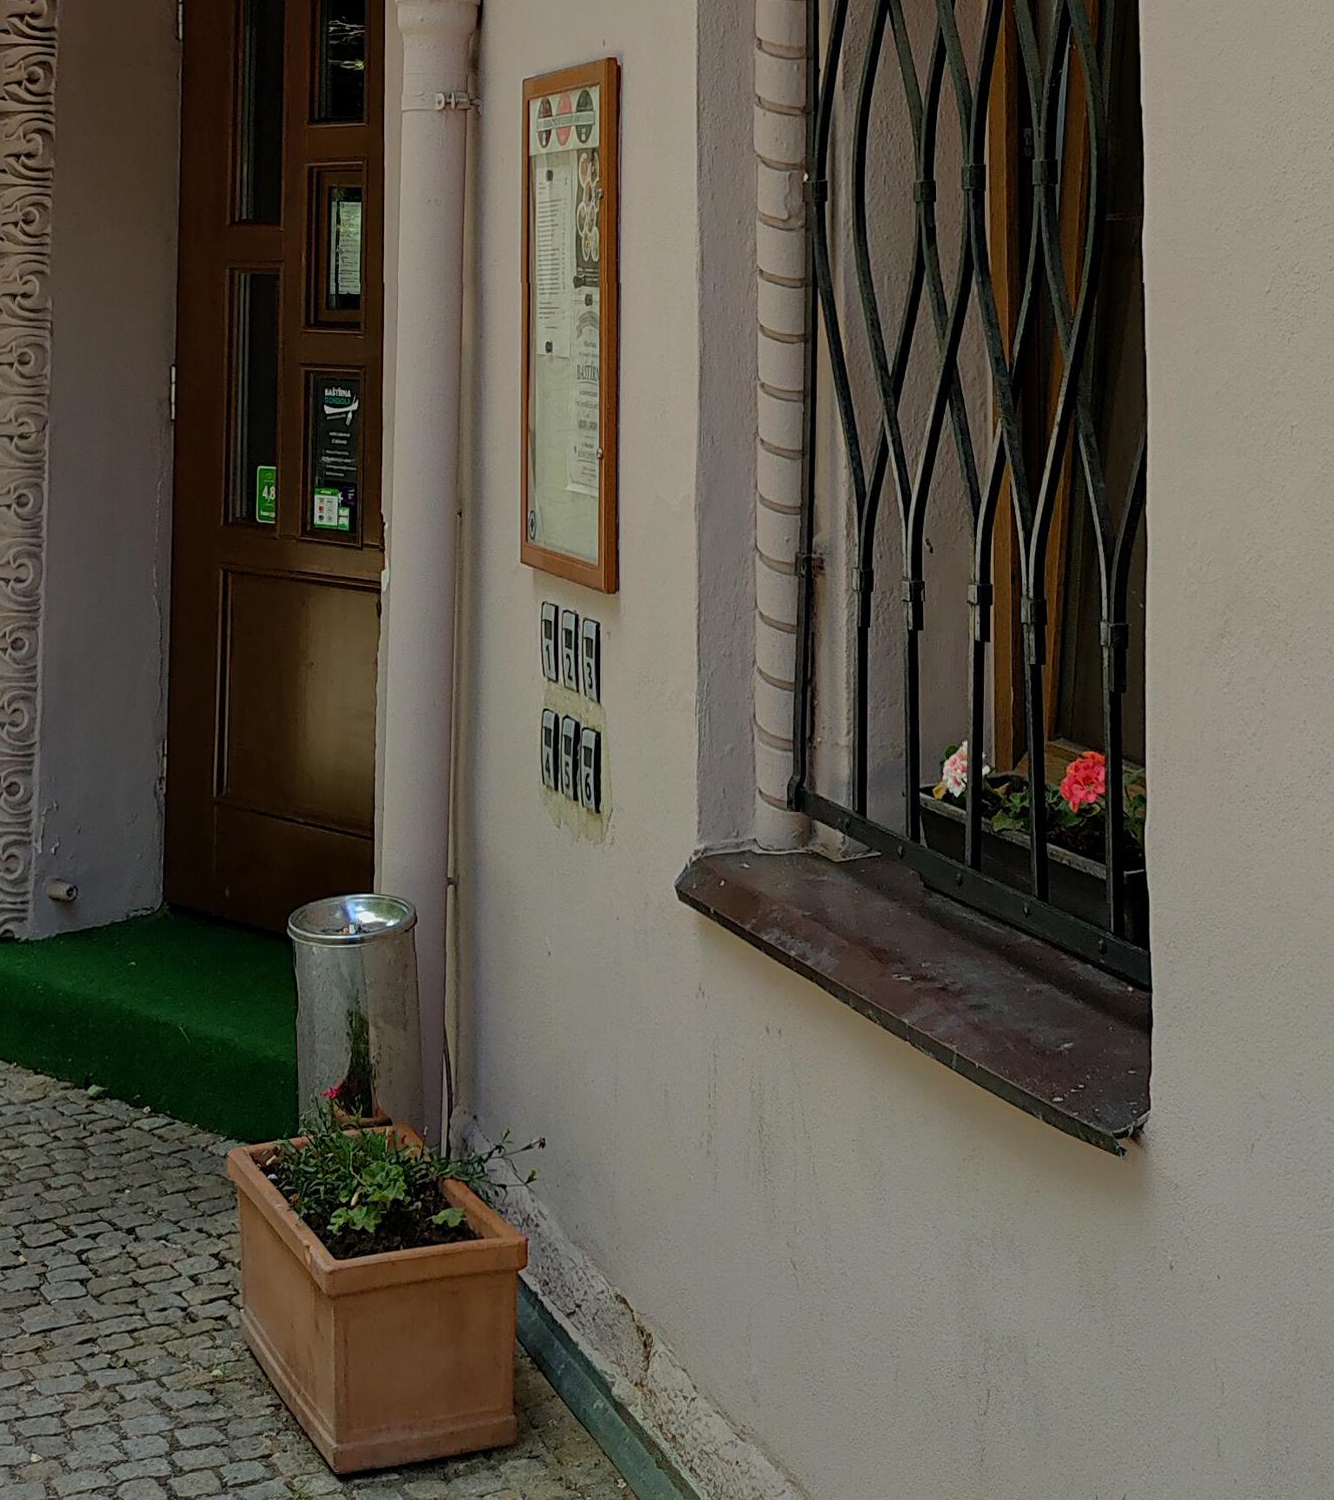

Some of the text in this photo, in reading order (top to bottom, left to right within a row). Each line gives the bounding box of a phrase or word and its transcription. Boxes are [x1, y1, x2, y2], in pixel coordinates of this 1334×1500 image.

[545, 643, 593, 690] 1 2 3
[544, 752, 593, 801] 4 5 6
